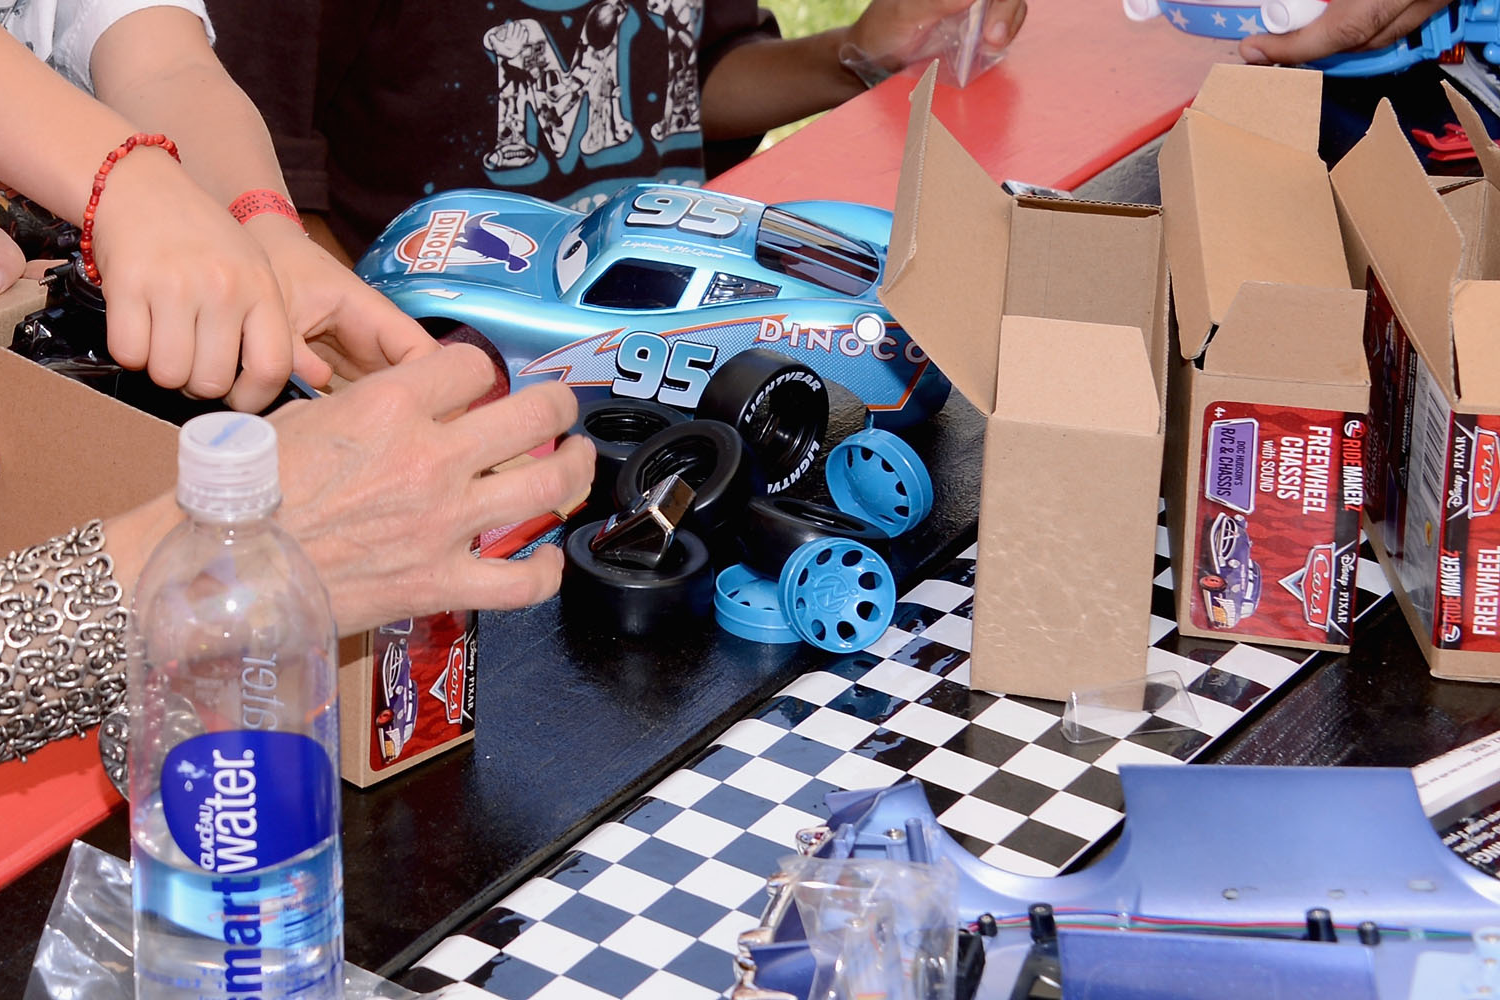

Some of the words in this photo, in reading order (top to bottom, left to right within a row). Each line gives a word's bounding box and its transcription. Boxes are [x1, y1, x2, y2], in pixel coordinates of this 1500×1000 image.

[625, 192, 747, 238] 95
[419, 215, 459, 272] DINOCO
[758, 317, 930, 364] DINOCO
[611, 331, 719, 411] 95
[744, 371, 822, 424] LIGHTYEAR
[1214, 406, 1227, 418] 4+
[1219, 446, 1234, 454] &
[1220, 427, 1236, 445] R/C
[1237, 440, 1246, 454] DOC
[1261, 439, 1276, 456] with
[1453, 435, 1467, 469] PIXAR
[1216, 457, 1233, 497] CHASSIS
[1259, 456, 1275, 493] SOUND
[1276, 436, 1304, 500] CHASSIS
[1302, 425, 1333, 515] FREEWHEEL
[1474, 441, 1496, 508] Cars
[1447, 472, 1467, 508] Disney
[1309, 552, 1332, 618] Cars
[1340, 552, 1358, 590] Disney
[1472, 545, 1500, 636] FREEWHEEL
[1336, 592, 1350, 625] PIXAR
[449, 647, 464, 716] Cars
[466, 676, 476, 711] PIXAR
